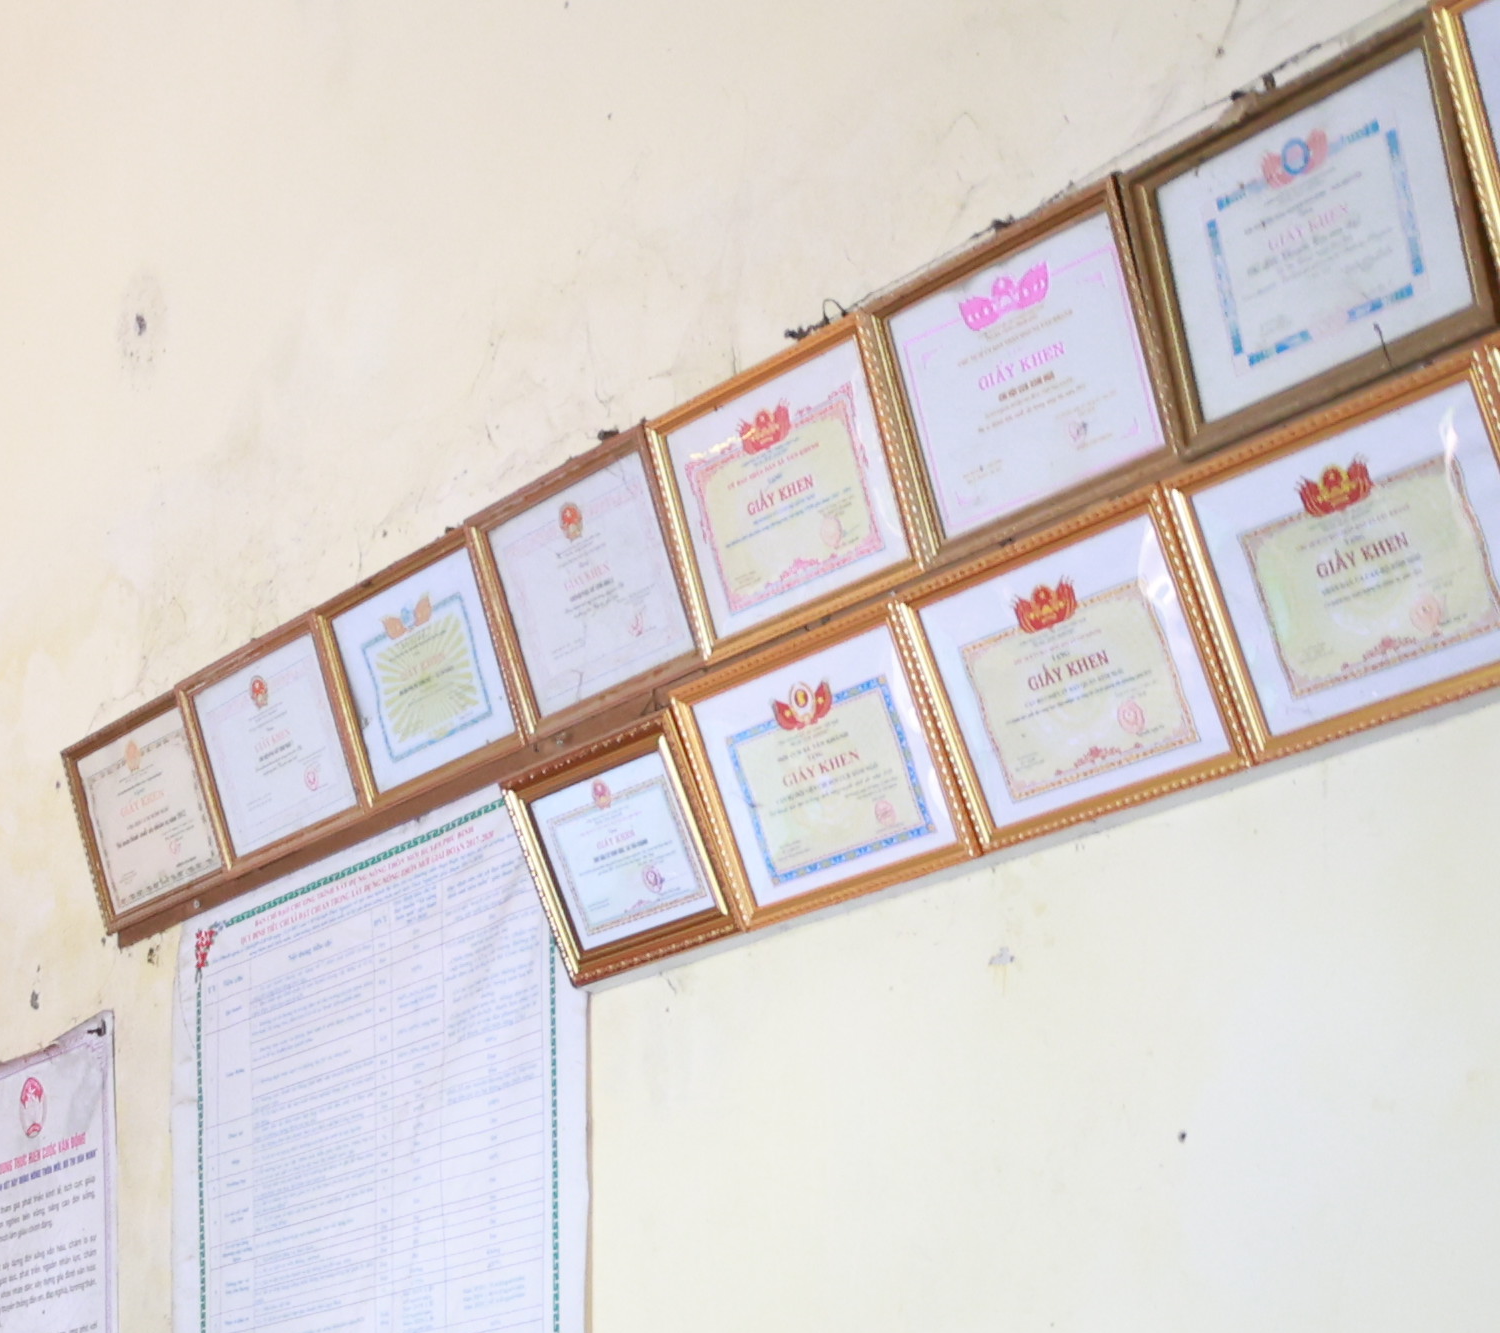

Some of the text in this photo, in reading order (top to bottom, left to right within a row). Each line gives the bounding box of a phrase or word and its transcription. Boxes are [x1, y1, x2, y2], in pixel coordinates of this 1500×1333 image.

[747, 474, 813, 515] GIẤY KHEN
[1317, 532, 1408, 578] GIẤY KHEN
[1028, 649, 1109, 692] GIẤY KHEN
[783, 767, 815, 787] GIẤY
[819, 750, 859, 773] KHEN
